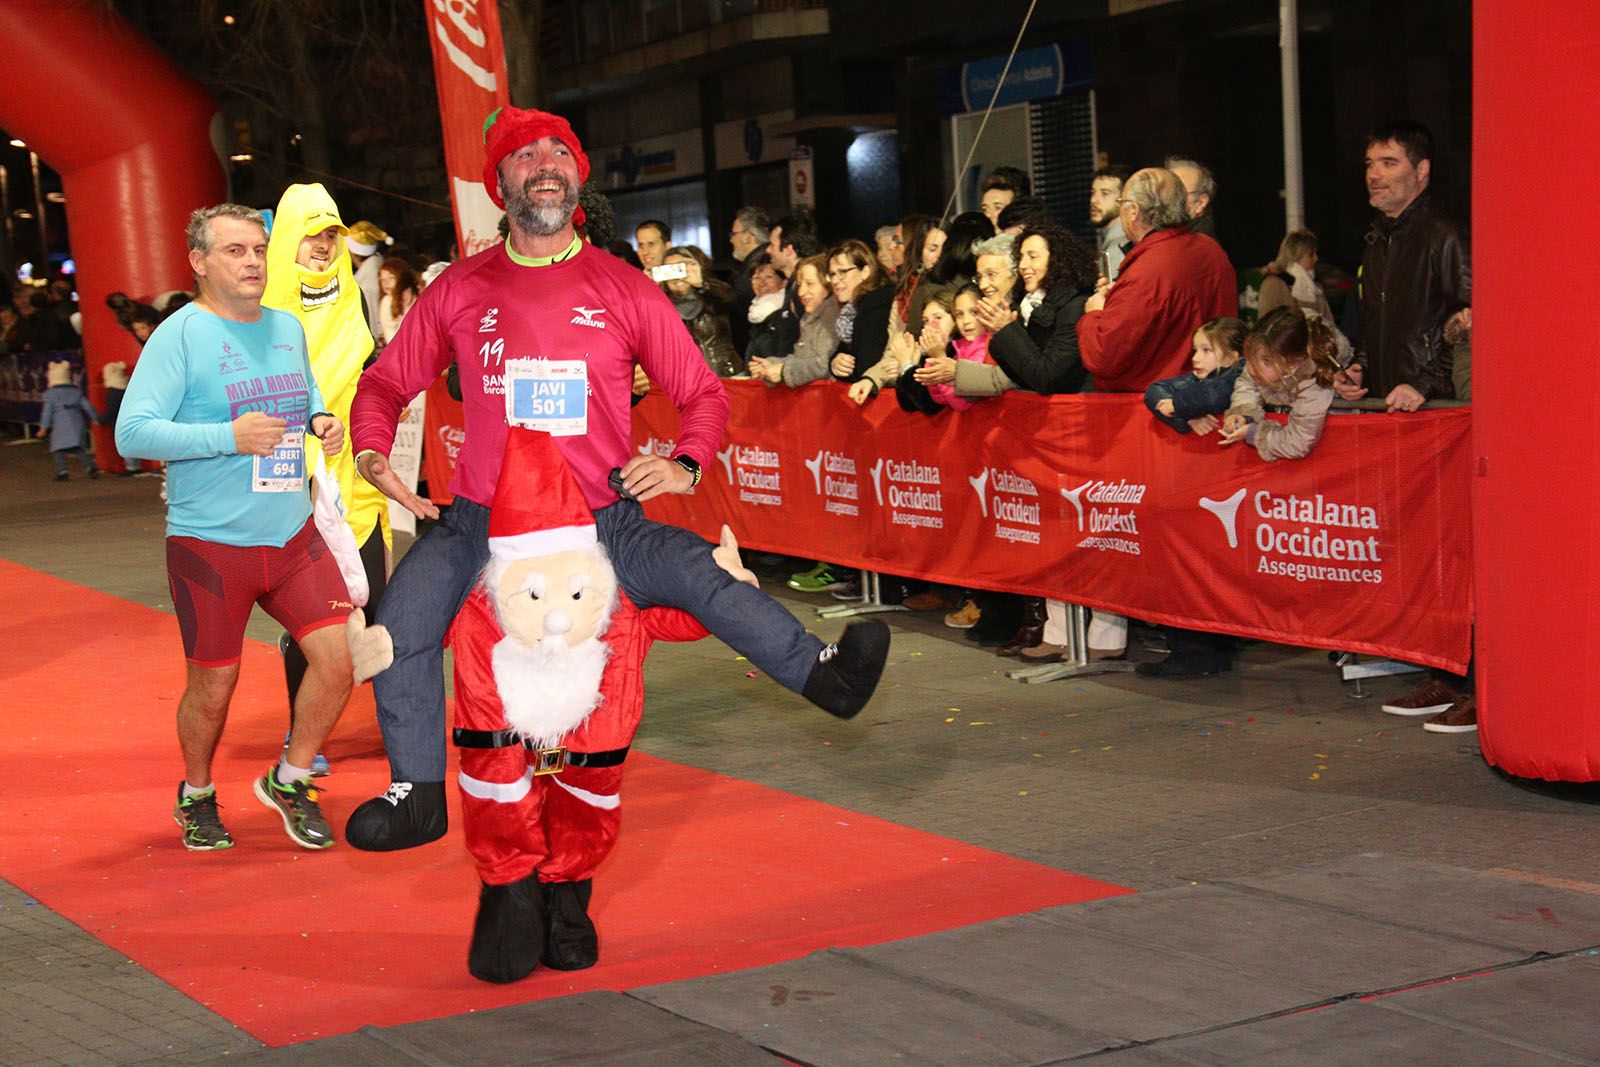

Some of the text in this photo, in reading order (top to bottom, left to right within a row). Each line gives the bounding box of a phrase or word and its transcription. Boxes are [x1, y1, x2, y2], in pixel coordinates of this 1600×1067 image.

[479, 337, 504, 368] 19
[225, 377, 265, 401] MITJA
[531, 382, 566, 398] JAVI
[277, 395, 308, 414] 25
[532, 399, 566, 415] 501
[273, 463, 296, 476] 694
[886, 459, 941, 485] Catalana
[990, 467, 1039, 496] Catalana
[888, 485, 943, 512] Occident
[1086, 478, 1146, 504] Catalana
[892, 510, 944, 529] Assegurances
[993, 495, 1041, 526] Occident
[1254, 490, 1380, 530] Catalana
[994, 523, 1041, 545] Assegurances
[1256, 523, 1382, 562] Occident
[1257, 555, 1383, 584] Assegurances
